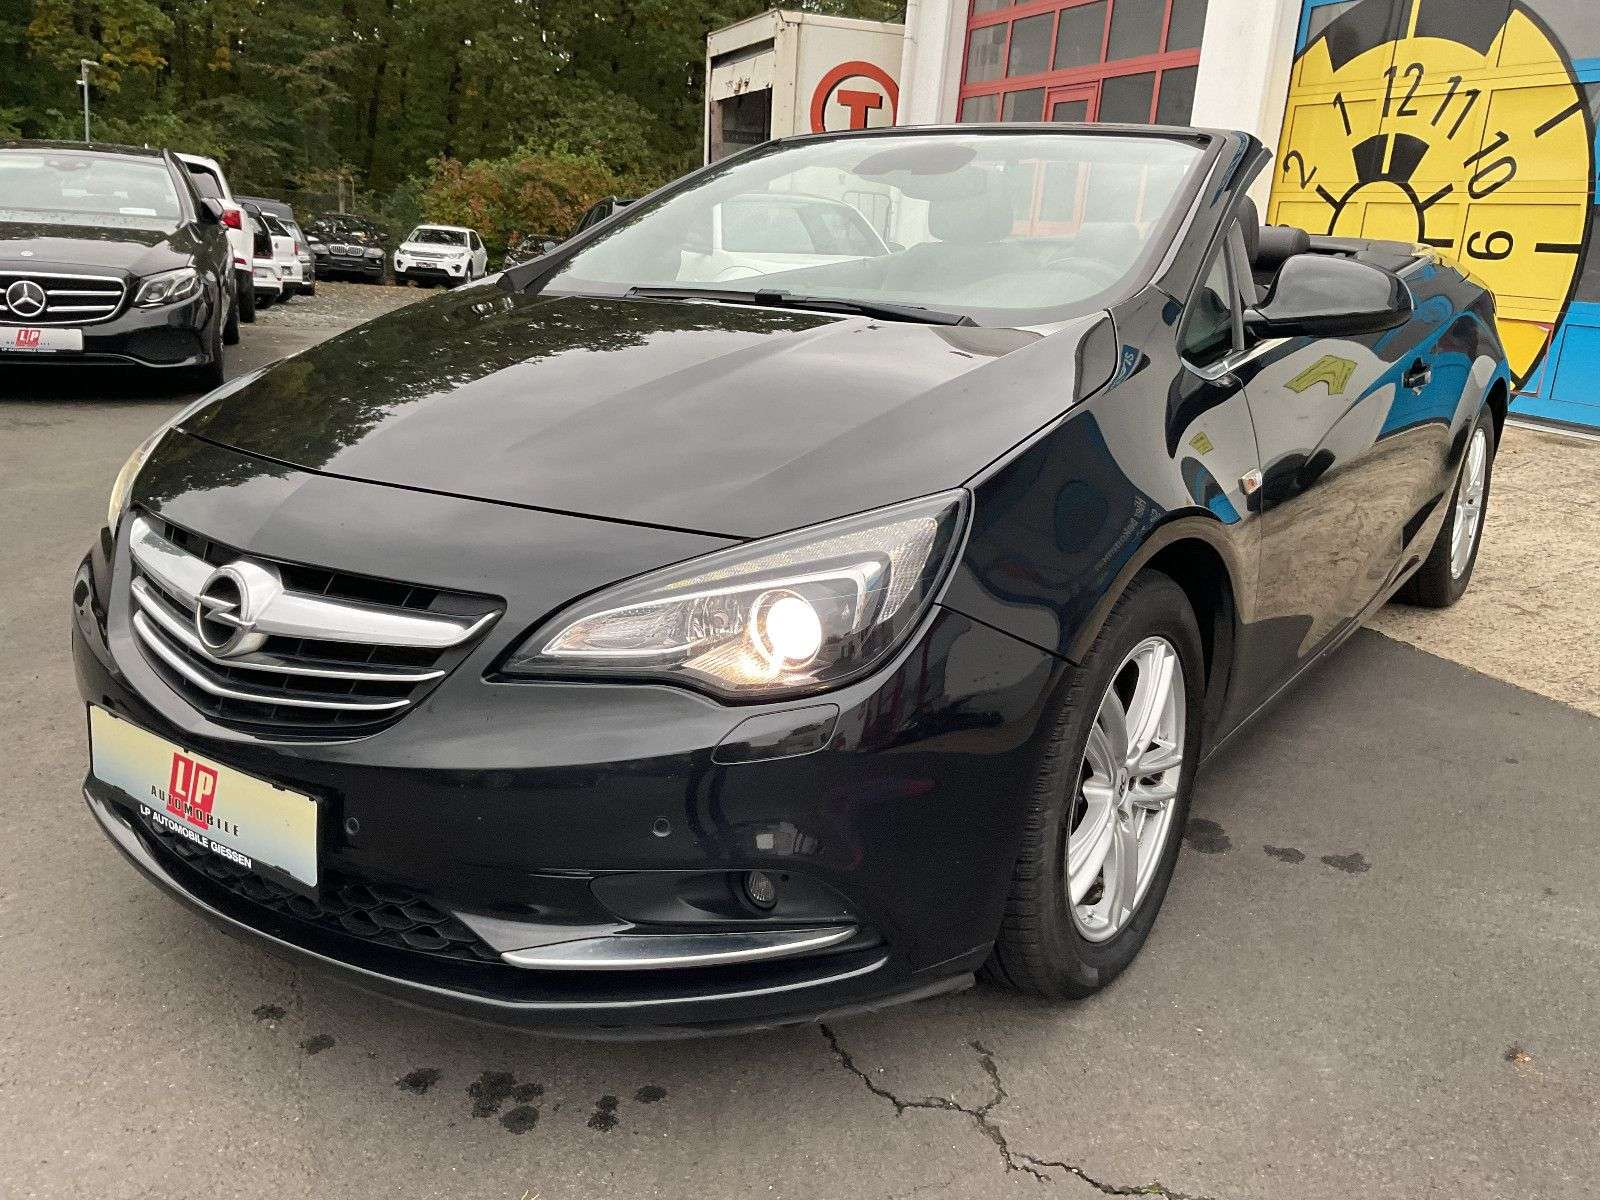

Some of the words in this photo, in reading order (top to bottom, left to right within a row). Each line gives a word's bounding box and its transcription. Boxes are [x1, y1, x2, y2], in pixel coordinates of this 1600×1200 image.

[837, 89, 883, 129] T
[1332, 91, 1352, 136] 1
[1382, 62, 1425, 118] 12
[1430, 75, 1482, 140] 11
[1283, 149, 1318, 190] 2
[1463, 131, 1517, 200] 10
[1466, 229, 1514, 261] 9
[175, 759, 214, 804] LP
[151, 785, 239, 837] AUTOMOBILE
[140, 804, 151, 816] LP
[152, 811, 209, 848] AUTOMOBILE
[210, 841, 252, 869] GIESSEN
